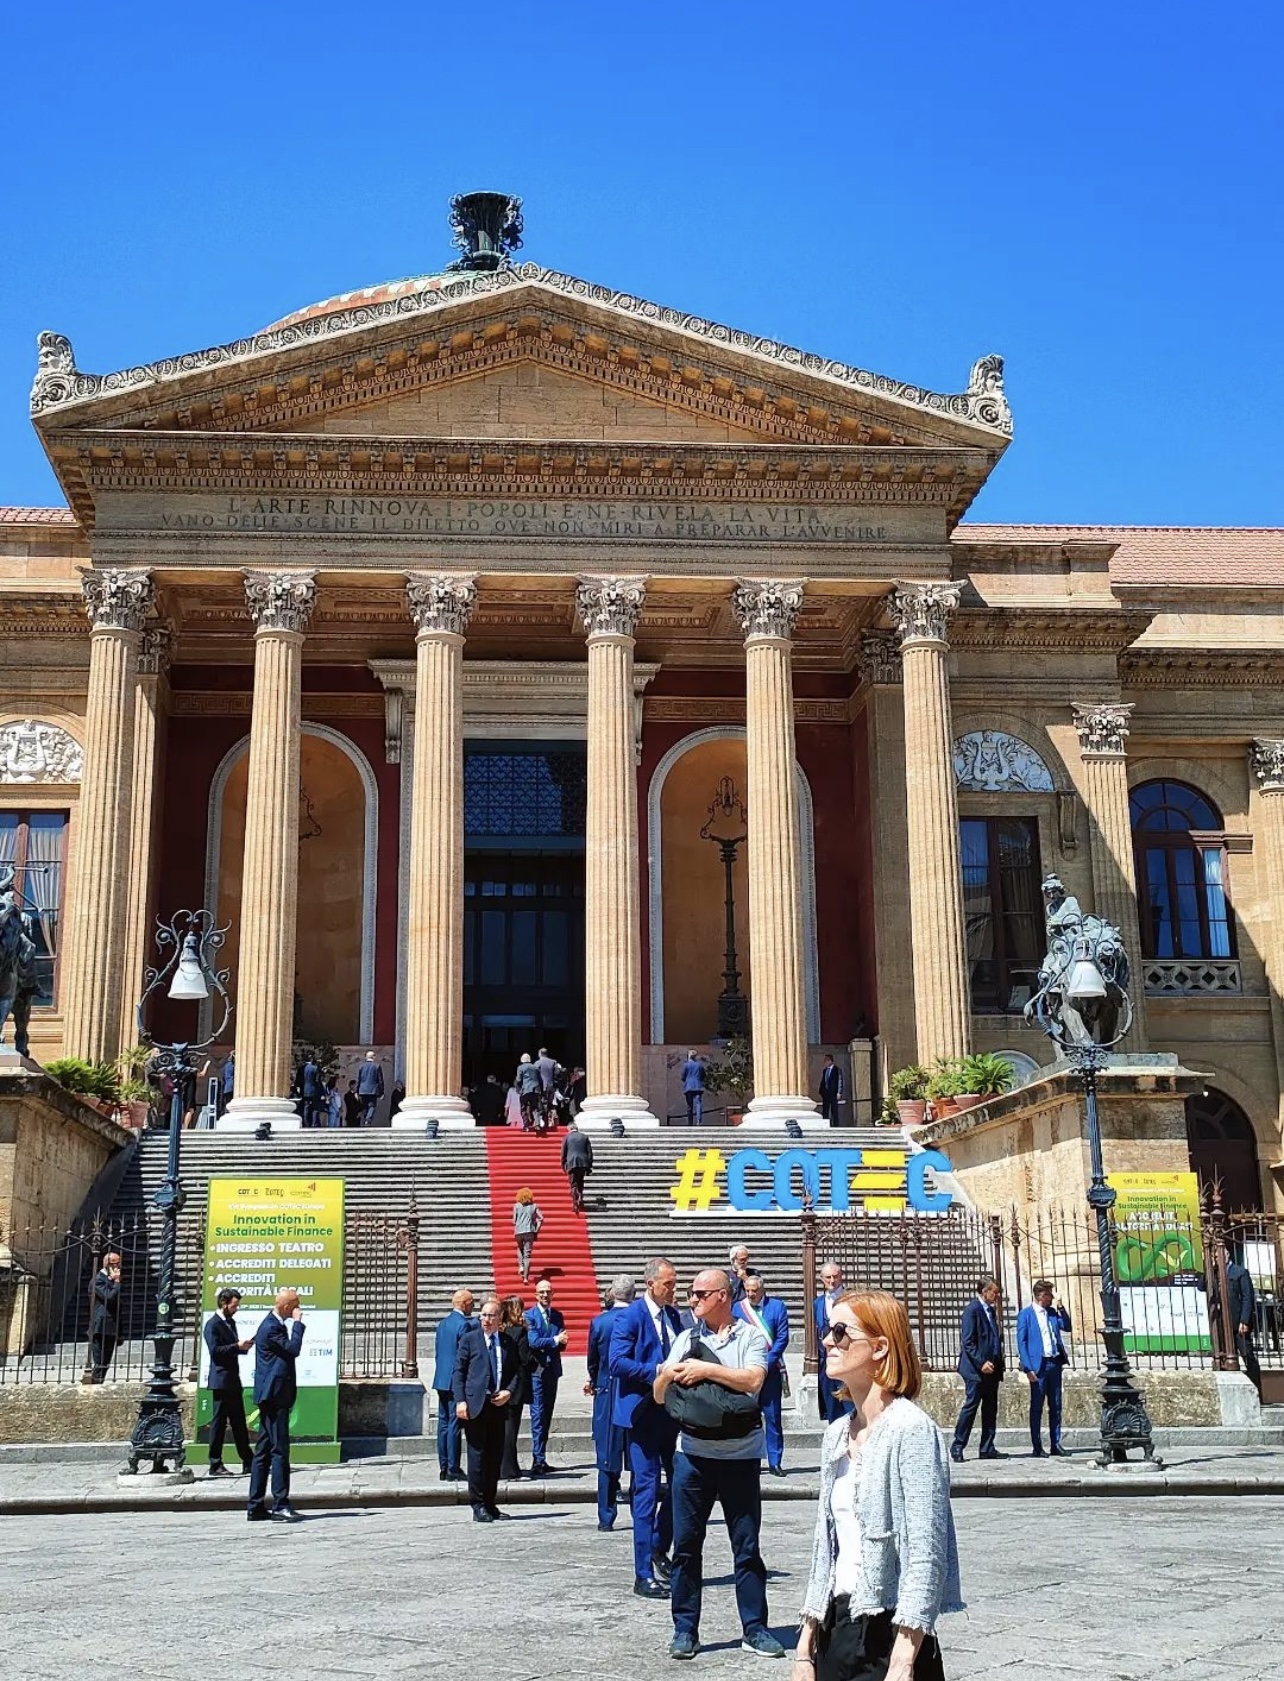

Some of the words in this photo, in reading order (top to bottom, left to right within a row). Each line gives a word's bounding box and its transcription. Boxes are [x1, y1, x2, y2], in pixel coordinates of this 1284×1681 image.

[229, 497, 310, 514] L'ARTE
[325, 499, 432, 516] RINNOVA
[446, 501, 452, 517] I
[467, 502, 548, 518] POPOLI
[563, 504, 573, 519] E
[587, 505, 617, 520] NE
[632, 506, 715, 521] RIVELA
[730, 508, 754, 522] LA
[767, 508, 821, 524] VITA
[162, 514, 214, 526] VANO
[294, 516, 359, 529] SCENE
[372, 518, 391, 529] IL
[495, 520, 530, 532] OVE
[544, 521, 584, 533] NON
[601, 522, 641, 534] MIRI
[654, 524, 664, 535] A
[676, 524, 770, 537] PREPARAR
[783, 525, 887, 539] L'AVVENIRE
[233, 1213, 301, 1224] Innovation
[304, 1213, 316, 1224] in
[215, 1225, 285, 1236] Sustainable
[287, 1225, 333, 1236] Finance
[215, 1243, 275, 1253] INGRESSO
[278, 1242, 324, 1252] TEATRO
[215, 1258, 276, 1268] ACCREDITI
[280, 1258, 331, 1268] DELEGATI
[214, 1273, 276, 1283] ACCREDITI
[214, 1284, 272, 1296] AORITÀ
